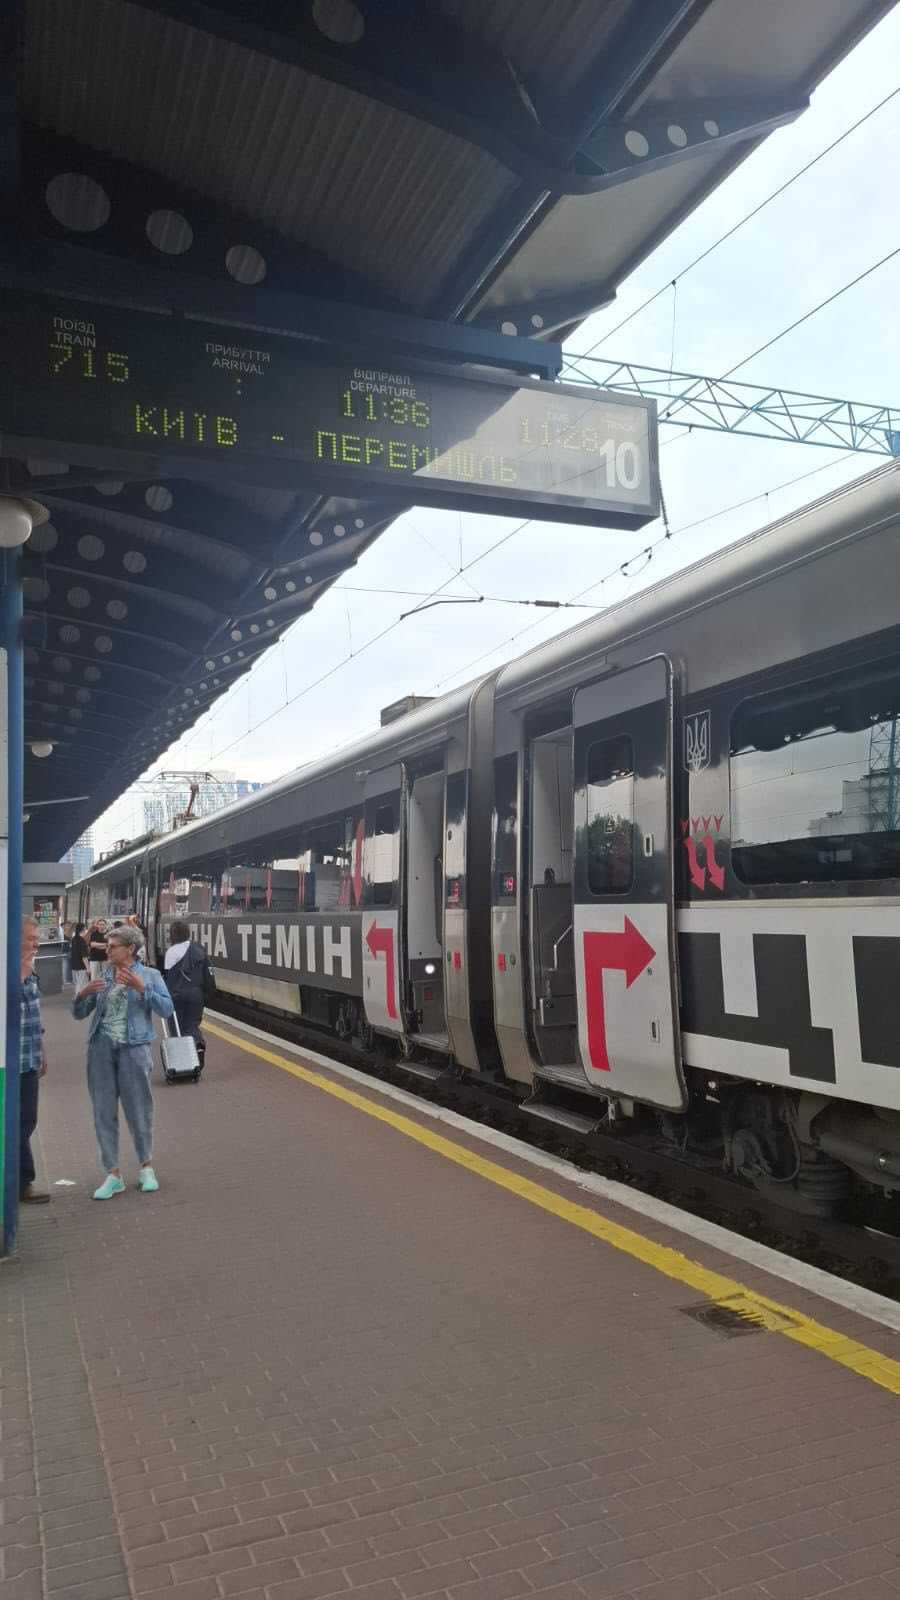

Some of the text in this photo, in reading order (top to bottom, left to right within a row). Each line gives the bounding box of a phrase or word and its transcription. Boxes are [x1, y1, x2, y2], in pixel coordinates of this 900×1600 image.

[53, 316, 96, 336] ПОЇЗД
[55, 331, 97, 348] TRAIN
[205, 342, 271, 362] ПРИБУТТЯ
[50, 343, 129, 383] 715
[212, 357, 265, 376] ARRIVAL
[350, 380, 417, 400] DEPARTURE
[343, 390, 430, 428] 11:36
[135, 404, 238, 445] КИЇВ
[600, 438, 641, 490] 10
